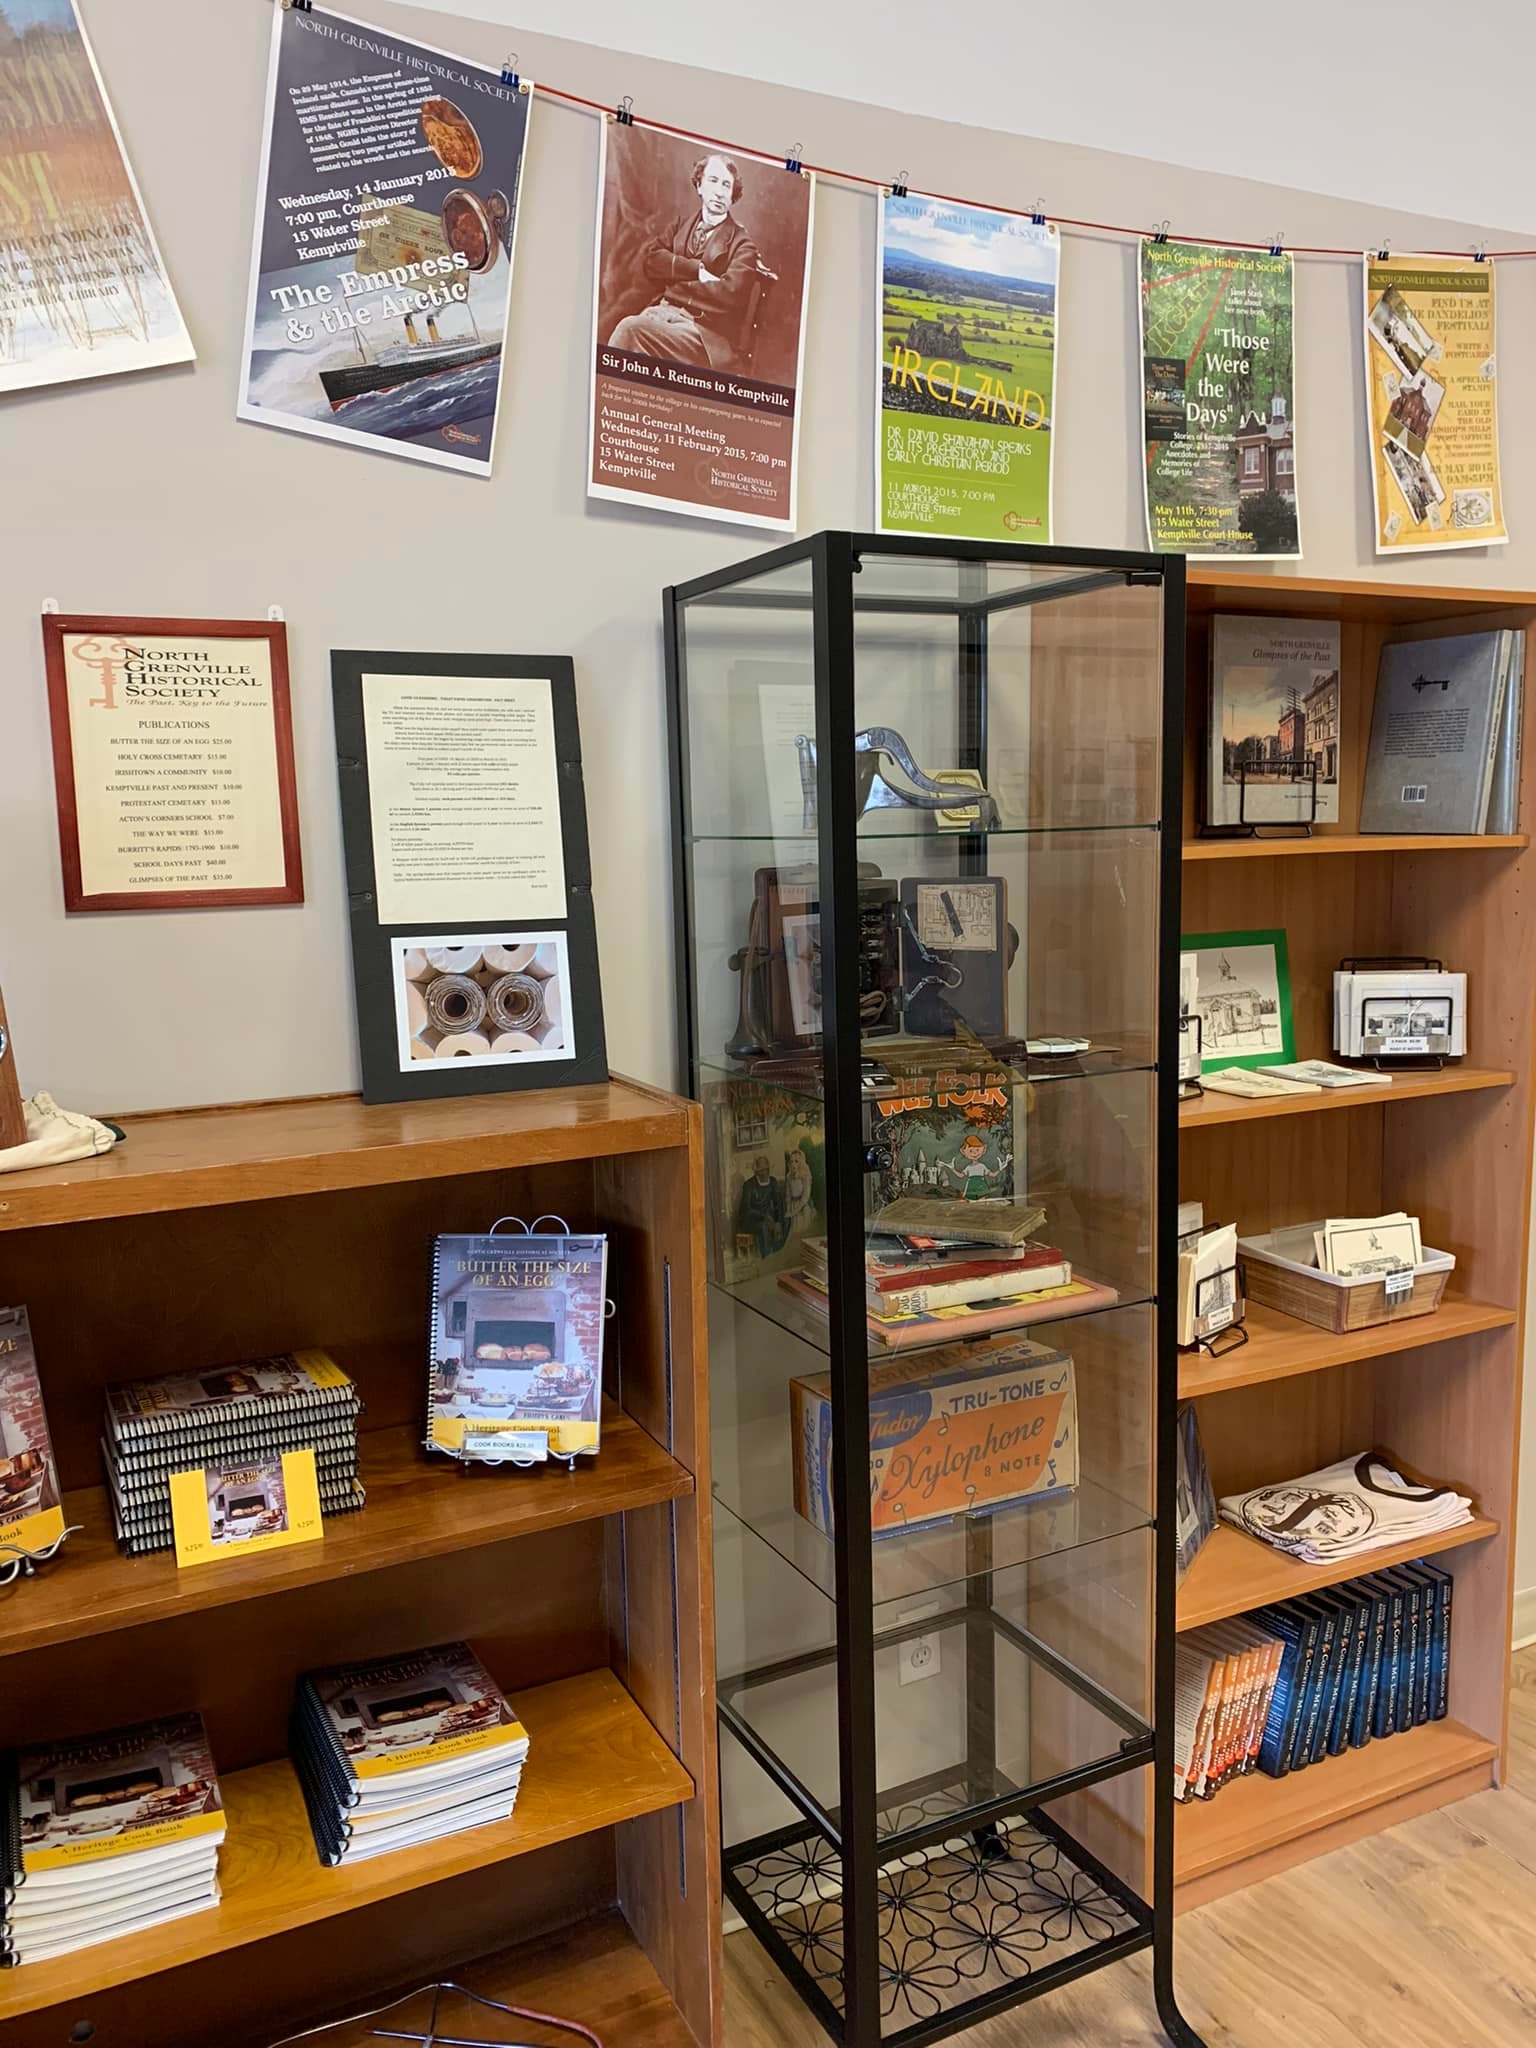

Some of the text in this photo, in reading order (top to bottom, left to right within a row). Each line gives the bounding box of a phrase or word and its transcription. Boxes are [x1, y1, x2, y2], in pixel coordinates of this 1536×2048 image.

[296, 15, 517, 104] NORTH GRENVILLE HISTORICAL SOCIETY
[279, 188, 353, 210] Wednesday,
[355, 184, 371, 195] 14
[373, 174, 423, 194] January
[286, 192, 415, 226] 7:00 pm, Courthouse
[292, 214, 390, 243] 15 Water Street
[297, 237, 366, 260] Kemptville
[1148, 250, 1285, 275] North Grenville Historical Society
[68, 285, 119, 301] LIBRARY
[270, 251, 469, 314] The Empress
[286, 281, 468, 343] & the Arctic
[1427, 310, 1489, 319] DANDELION
[1214, 328, 1270, 350] "Those
[1206, 352, 1249, 374] Were
[602, 354, 789, 407] Sir John A. Returns to Kemptville
[890, 345, 1046, 430] IRELAND
[1198, 378, 1224, 398] the
[601, 406, 726, 444] Annual General Meeting
[1186, 403, 1233, 429] Days"
[600, 433, 660, 454] Courthouse
[601, 419, 787, 468] Wednesday, 11 February 2015, 7:00 pm
[888, 439, 1010, 463] ON ITS PREHISTORY AND
[908, 429, 939, 443] DAVID
[943, 432, 994, 451] SHANAHAN
[998, 439, 1031, 456] SPEAKS
[600, 446, 675, 472] 15 Water Street
[600, 459, 657, 481] Kemptville
[888, 450, 1009, 475] EARLY CHRISTIAN PERIOD
[1445, 464, 1464, 473] MAY
[888, 482, 899, 491] 11
[903, 484, 931, 495] MARCH
[984, 493, 995, 502] PM
[888, 491, 939, 505] COURTHOUSE
[888, 509, 934, 523] KEMPTVILLE
[889, 501, 962, 516] 15 WATER STREET
[1155, 506, 1233, 518] May 11th, 7:30 pm
[1156, 518, 1219, 527] 15 Water Street
[1157, 530, 1253, 541] Kemptville Court House
[124, 647, 208, 661] NORTH
[1313, 651, 1330, 660] Past
[124, 660, 251, 674] GRENVILLE
[125, 673, 262, 687] HISTORICAL
[125, 685, 221, 698] SOCIETY
[179, 700, 198, 708] Key
[139, 721, 210, 729] PUBLICATIONS
[105, 784, 150, 792] KEMPTVILLE
[935, 1069, 1008, 1109] FOLK
[522, 1261, 553, 1273] THE
[558, 1262, 591, 1273] SIZE
[472, 1274, 494, 1286] OF
[498, 1274, 519, 1286] AN
[950, 1379, 1046, 1413] TRU-TONE
[881, 1416, 1045, 1500] Xylophone
[984, 1454, 1041, 1477] 8 NOTE
[396, 1749, 435, 1760] Heritage
[439, 1741, 462, 1751] Cook
